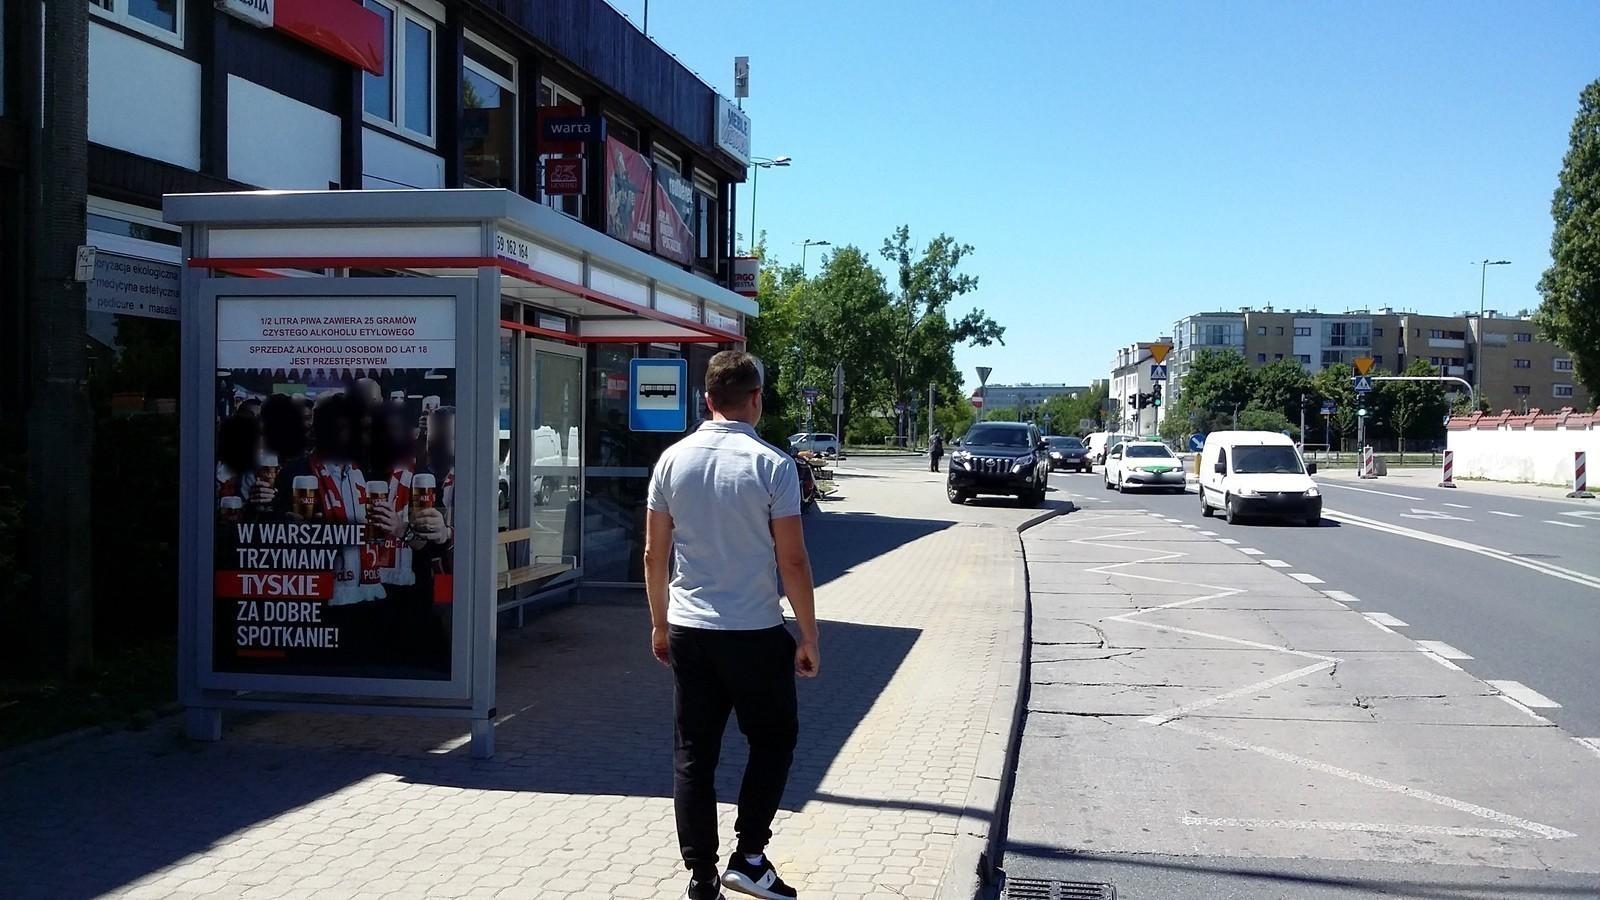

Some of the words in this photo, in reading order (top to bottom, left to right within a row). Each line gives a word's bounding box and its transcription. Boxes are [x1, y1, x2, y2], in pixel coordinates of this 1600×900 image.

[551, 124, 591, 133] warta
[519, 244, 528, 260] 164
[133, 265, 178, 280] ekologiczna
[96, 279, 138, 293] medycyna
[140, 283, 180, 298] estetyczna
[97, 297, 135, 309] pedicure
[261, 317, 272, 325] 1/2
[274, 317, 298, 325] LITRA
[300, 317, 323, 325] PIWA
[324, 317, 363, 325] ZAWIERA
[364, 317, 374, 325] 25
[376, 316, 417, 325] GRAMÓW
[263, 328, 308, 337] CZYSTEGO
[310, 328, 357, 337] ALKOHOLU
[360, 328, 415, 337] ETYLOWEGO
[249, 345, 295, 354] SPRZEDAŻ
[296, 346, 342, 354] ALKOHOLU
[345, 346, 383, 354] OSOBOM
[385, 346, 398, 354] DO
[401, 346, 416, 354] LAT
[290, 357, 310, 365] JEST
[313, 357, 387, 366] PRZESTĘPSTWEM
[237, 523, 253, 544] W
[259, 523, 366, 545] WARSZAWIE
[236, 548, 337, 569] TRZYMAMY
[237, 574, 320, 596] TYSKIE
[237, 601, 259, 621] ZA
[264, 601, 322, 622] DOBRE
[237, 626, 339, 648] SPOTKANIE!
